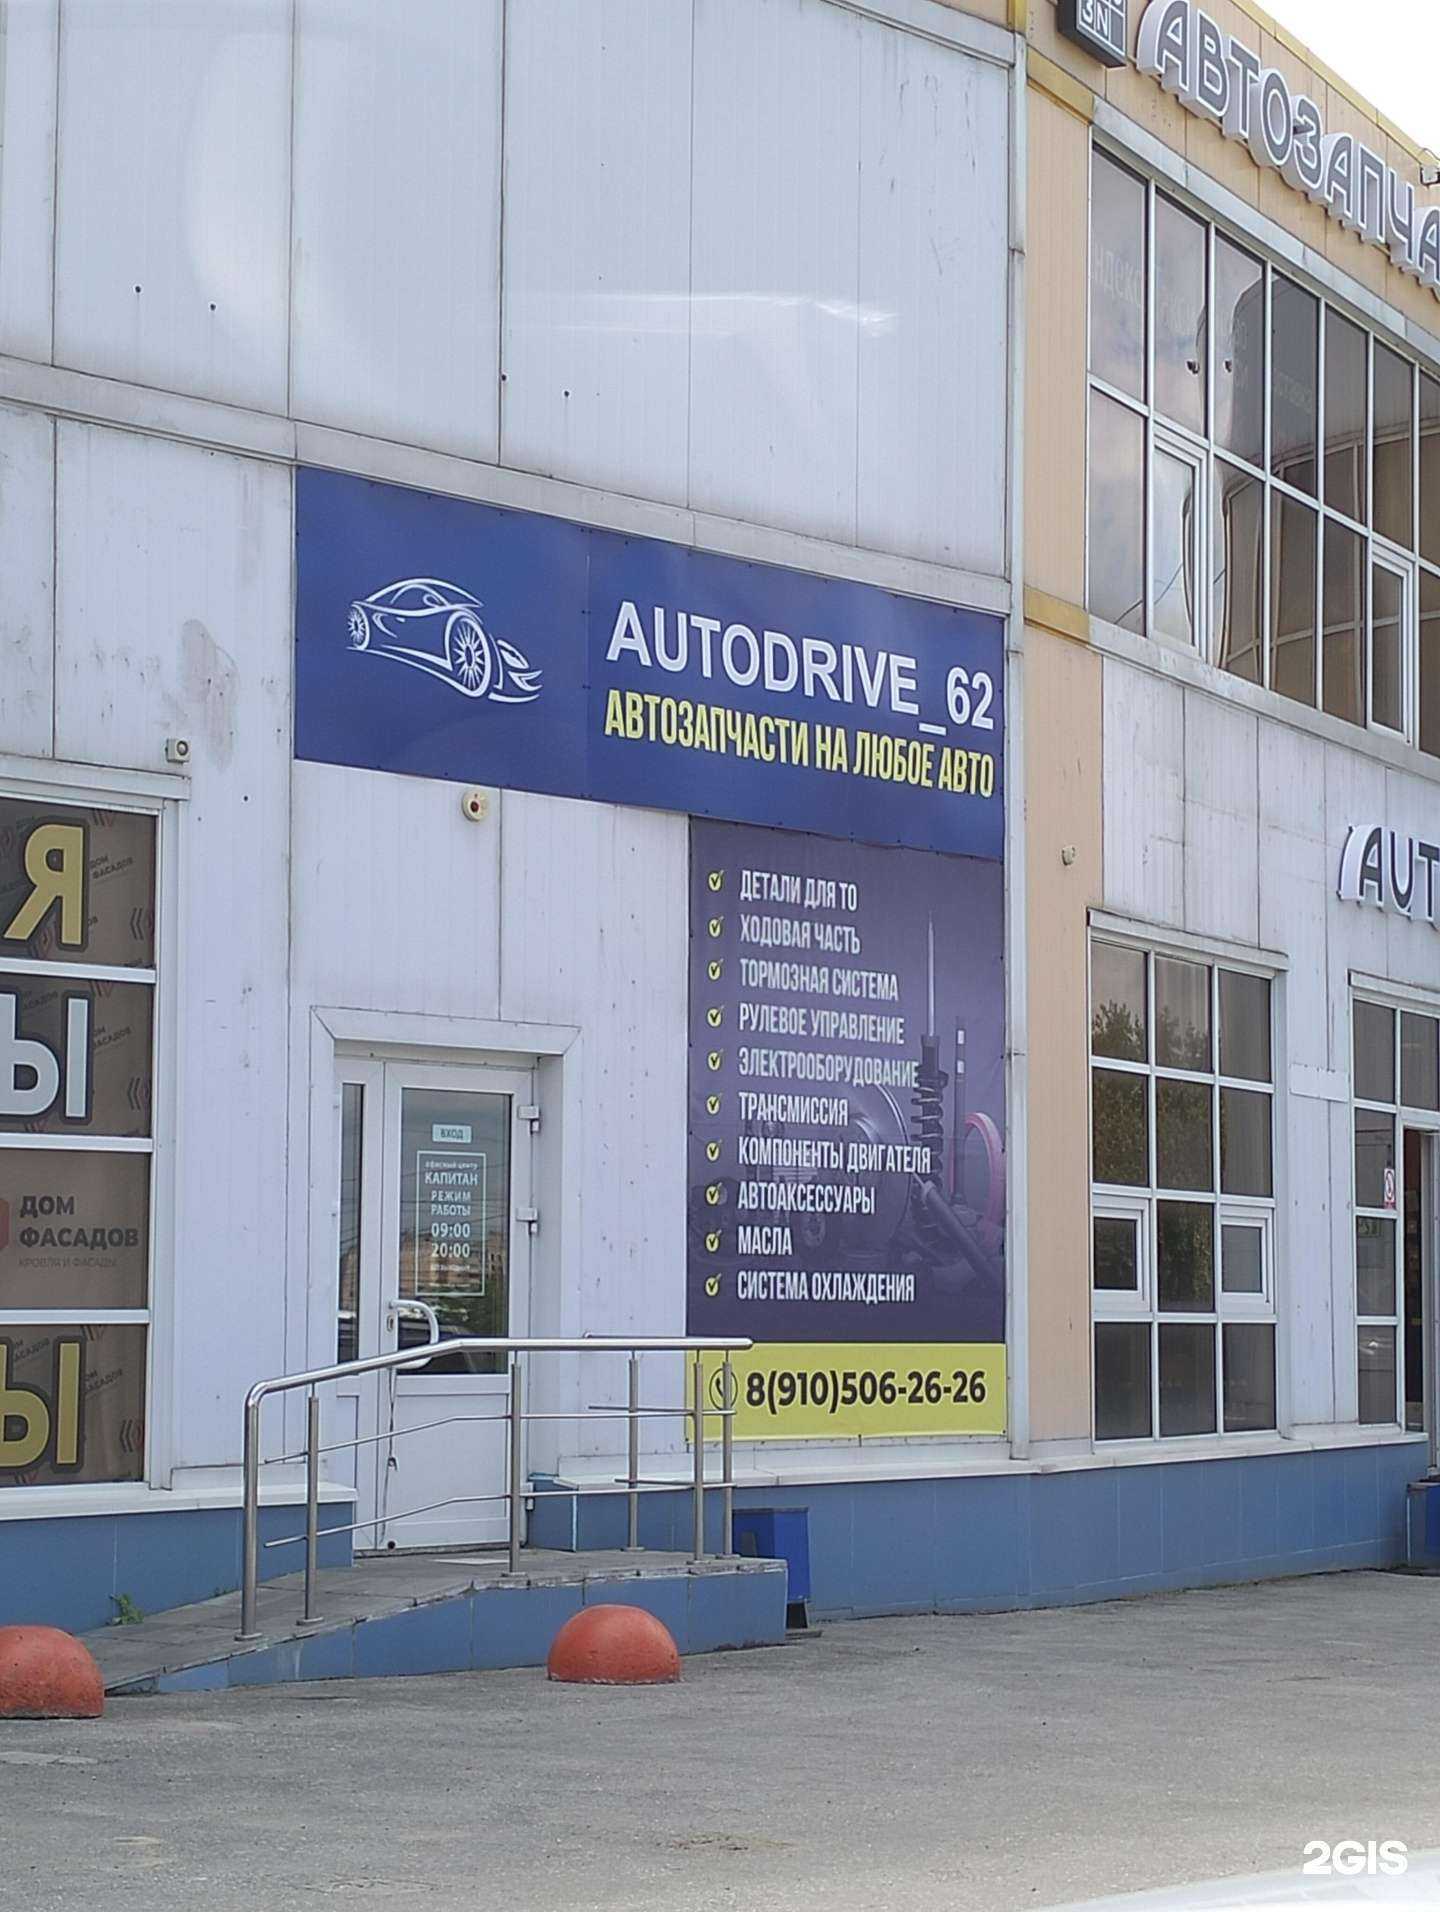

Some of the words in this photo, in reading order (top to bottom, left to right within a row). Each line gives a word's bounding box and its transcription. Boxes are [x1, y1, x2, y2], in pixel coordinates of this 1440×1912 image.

[606, 600, 994, 736] AUTODRIVE_62
[604, 689, 809, 768] АВТОЗАПЧАСТИ
[815, 724, 848, 773] НА
[853, 731, 935, 788] ЛЮБОЕ
[938, 747, 994, 798] АВТО
[3, 824, 84, 946] Я
[740, 870, 801, 904] ДЕТАЛИ
[804, 878, 836, 909] ДЛЯ
[839, 882, 858, 911] ТО
[740, 914, 811, 948] ХОДОВАЯ
[814, 922, 861, 954] ЧАСТЬ
[740, 958, 829, 994] ТОРМОЗНАЯ
[832, 968, 899, 1001] СИСТЕМА
[739, 1003, 807, 1036] РУЛЕВОЕ
[810, 1011, 905, 1044] УПРАВЛЕНИЕ
[739, 1047, 919, 1088] ЭЛЕКТРООБОРУДОВАНИЕ
[738, 1092, 849, 1126] ТРАНСМИССИЯ
[440, 1128, 464, 1140] ВХОД
[738, 1137, 843, 1169] КОМПОНЕНТЫ
[847, 1143, 931, 1173] ДВИГАТЕЛЯ
[425, 1172, 478, 1186] КАПИТАН
[20, 1196, 75, 1218] ДОМ
[431, 1190, 471, 1202] РЕЖИМ
[431, 1204, 471, 1216] РАБОТЫ
[738, 1181, 875, 1214] АВТОАКСЕССУАРЫ
[19, 1226, 139, 1251] ФАСАДОВ
[431, 1222, 471, 1238] 09:00
[738, 1226, 793, 1255] МАСЛА
[431, 1243, 471, 1258] 20:00
[737, 1271, 808, 1300] СИСТЕМА
[812, 1271, 915, 1304] ОХЛАЖДЕНИЯ
[746, 1370, 986, 1415] 8(910)506-26-26
